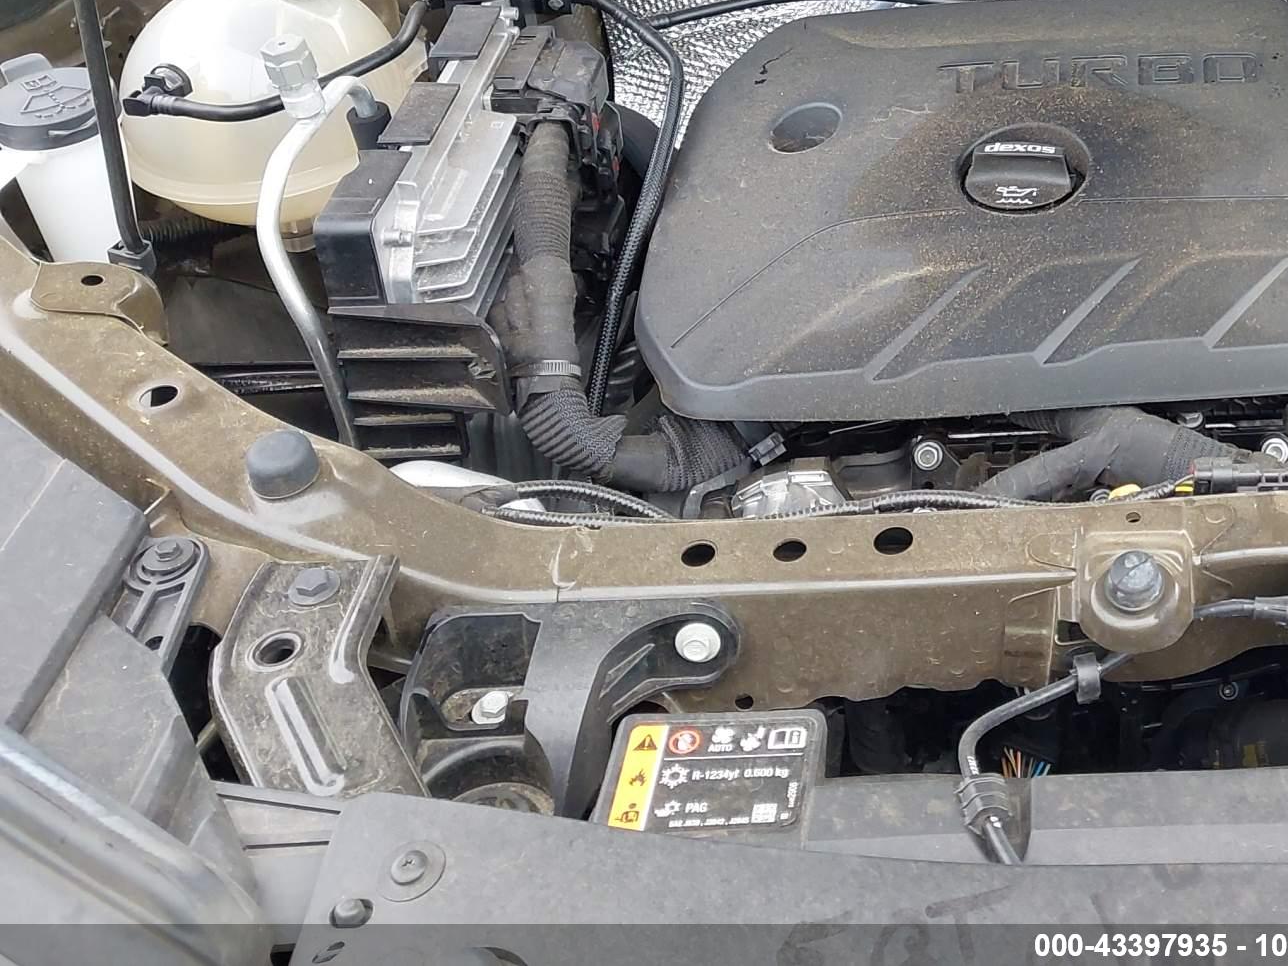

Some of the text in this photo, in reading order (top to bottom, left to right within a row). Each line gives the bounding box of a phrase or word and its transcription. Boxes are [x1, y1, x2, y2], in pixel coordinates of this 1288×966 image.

[937, 52, 1262, 93] TURBO
[984, 142, 1056, 154] dexos
[708, 744, 733, 753] AUTO
[775, 766, 790, 779] kg
[685, 802, 708, 813] PAG
